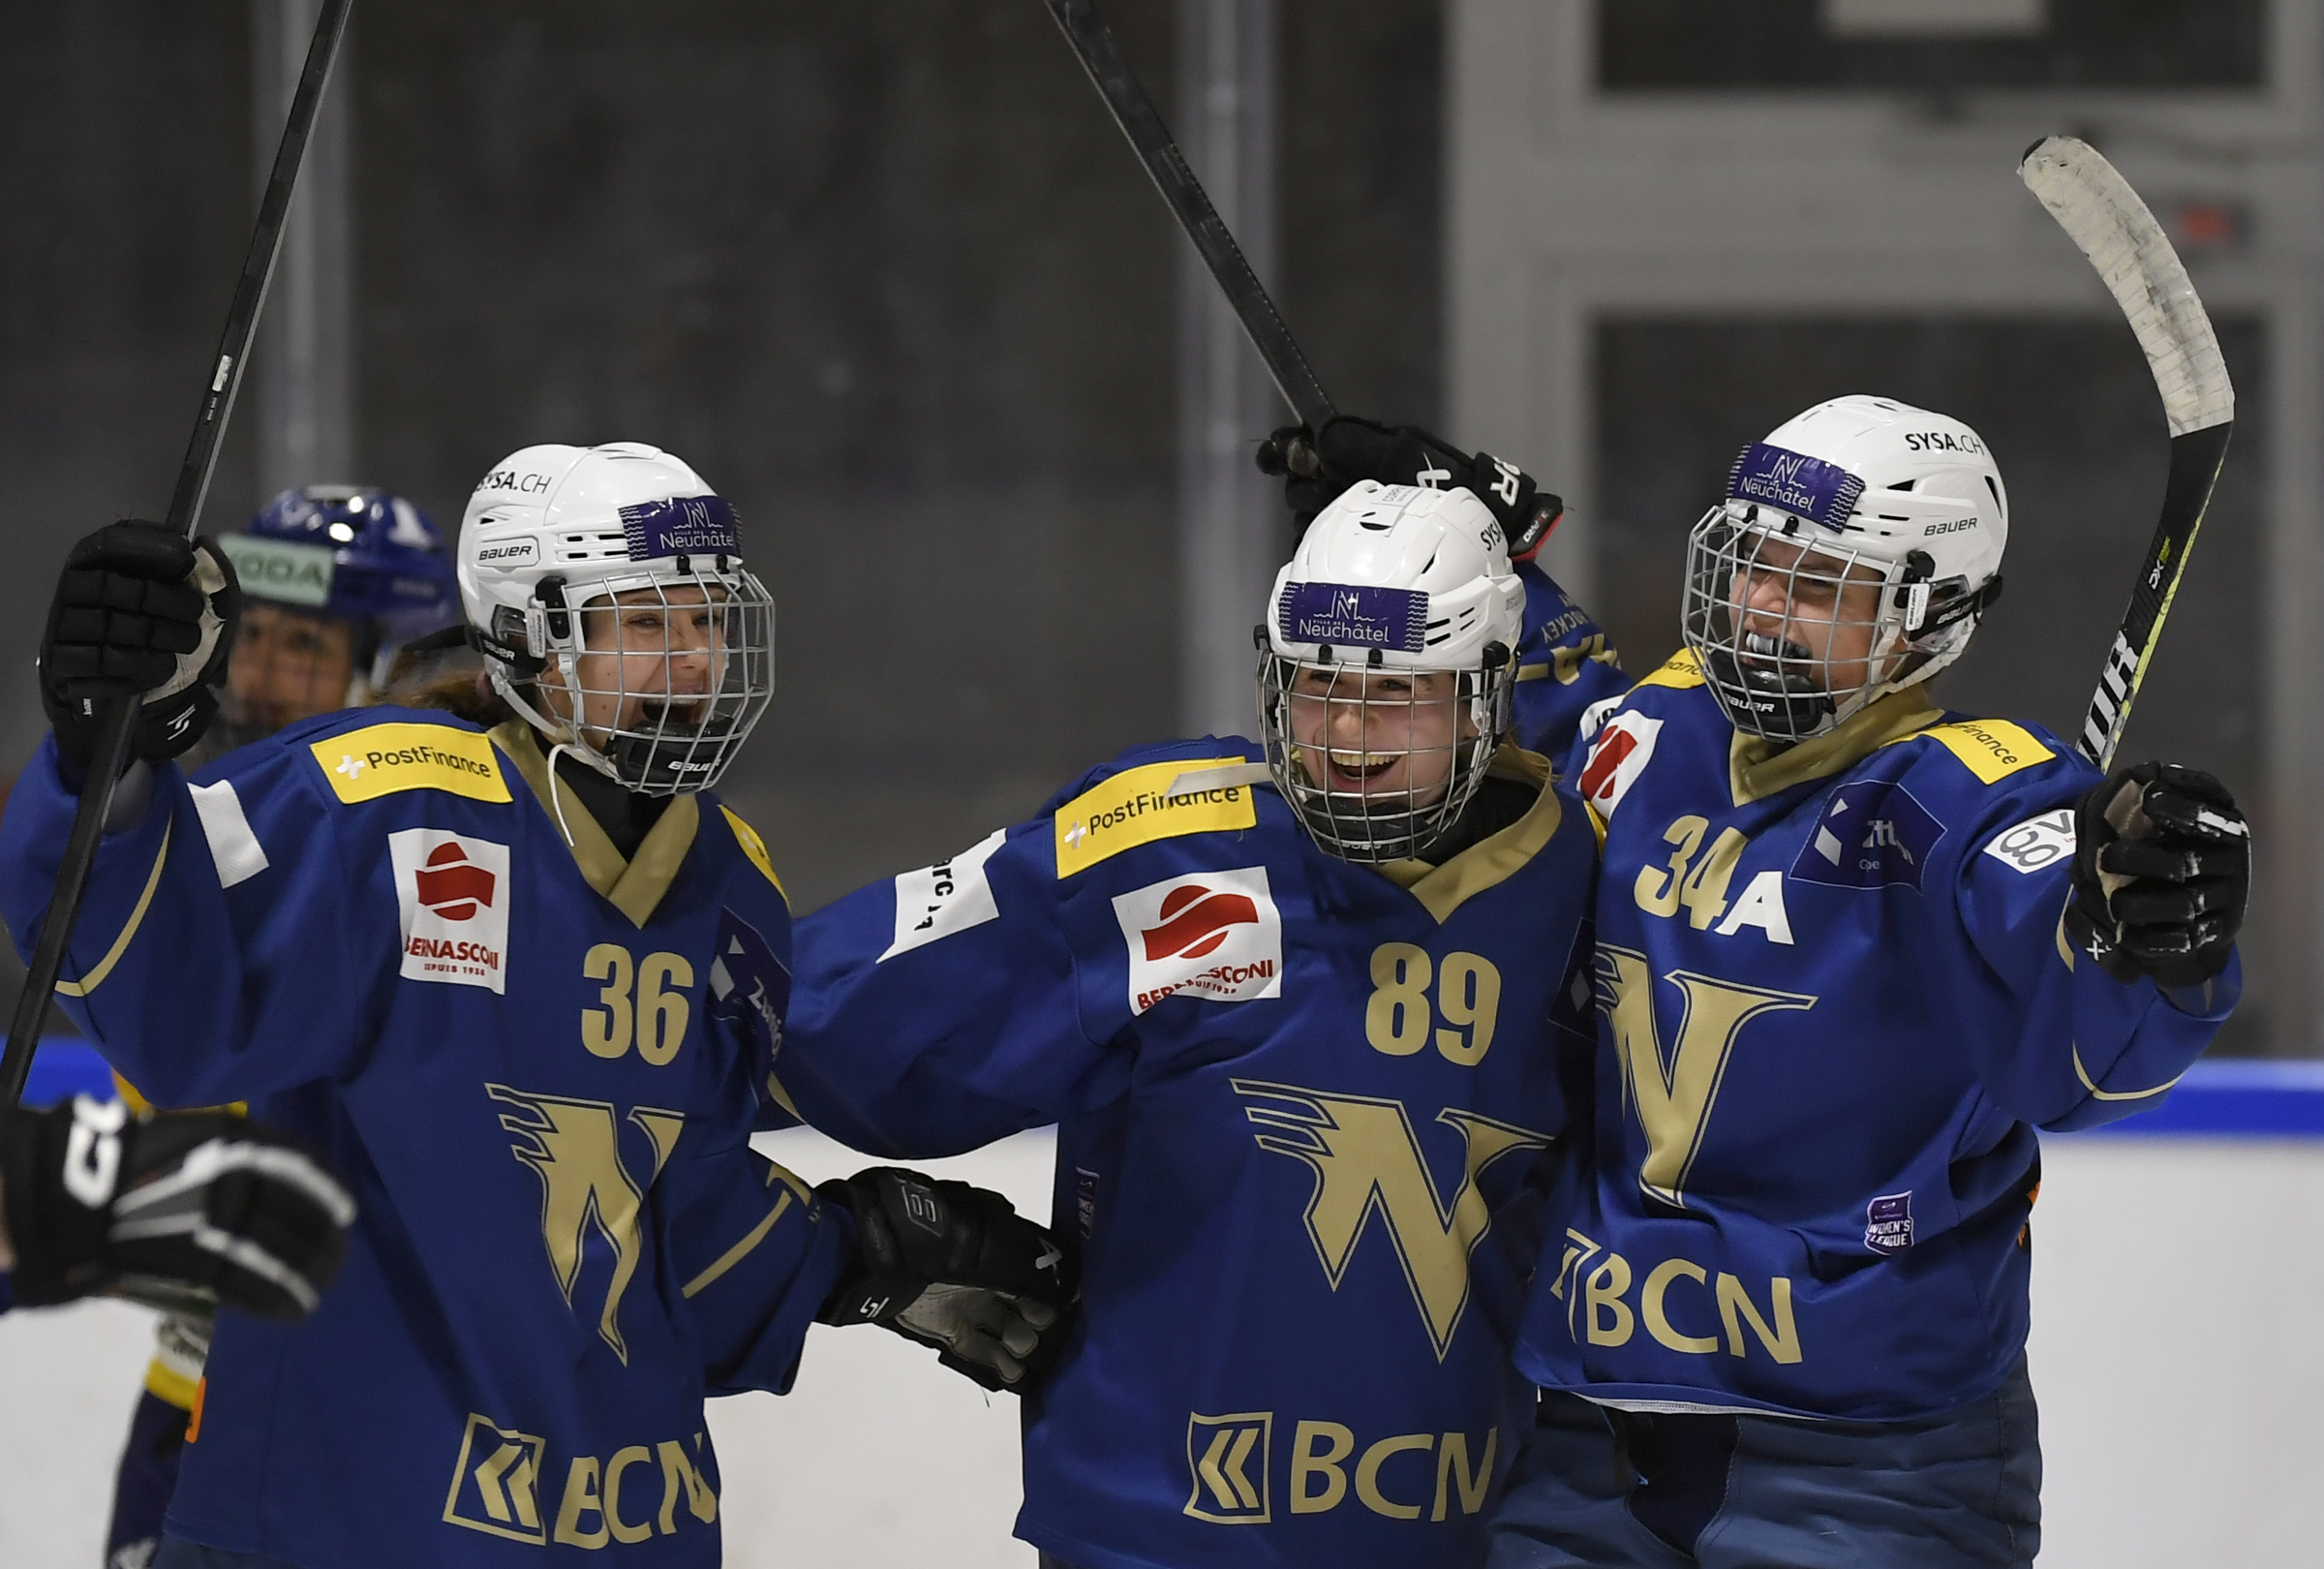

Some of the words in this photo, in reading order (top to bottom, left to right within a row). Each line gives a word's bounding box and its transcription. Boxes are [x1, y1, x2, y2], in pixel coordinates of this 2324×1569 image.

[1905, 432, 1985, 456] SYSA.CH
[1740, 476, 1817, 513] Neuchâtel
[659, 530, 734, 550] Neuchâte
[1923, 517, 1978, 537] BAUER
[478, 545, 533, 561] BAUER
[1299, 618, 1391, 643] Neuchâtel
[366, 745, 492, 779] PostFinance
[1634, 815, 1749, 931] 34
[1714, 871, 1795, 946] A
[581, 942, 695, 1066] 36
[1364, 941, 1501, 1066] 89
[1868, 1219, 1911, 1235] WOMEN'S
[1585, 1251, 1804, 1365] BCN
[1290, 1419, 1498, 1523] BCN
